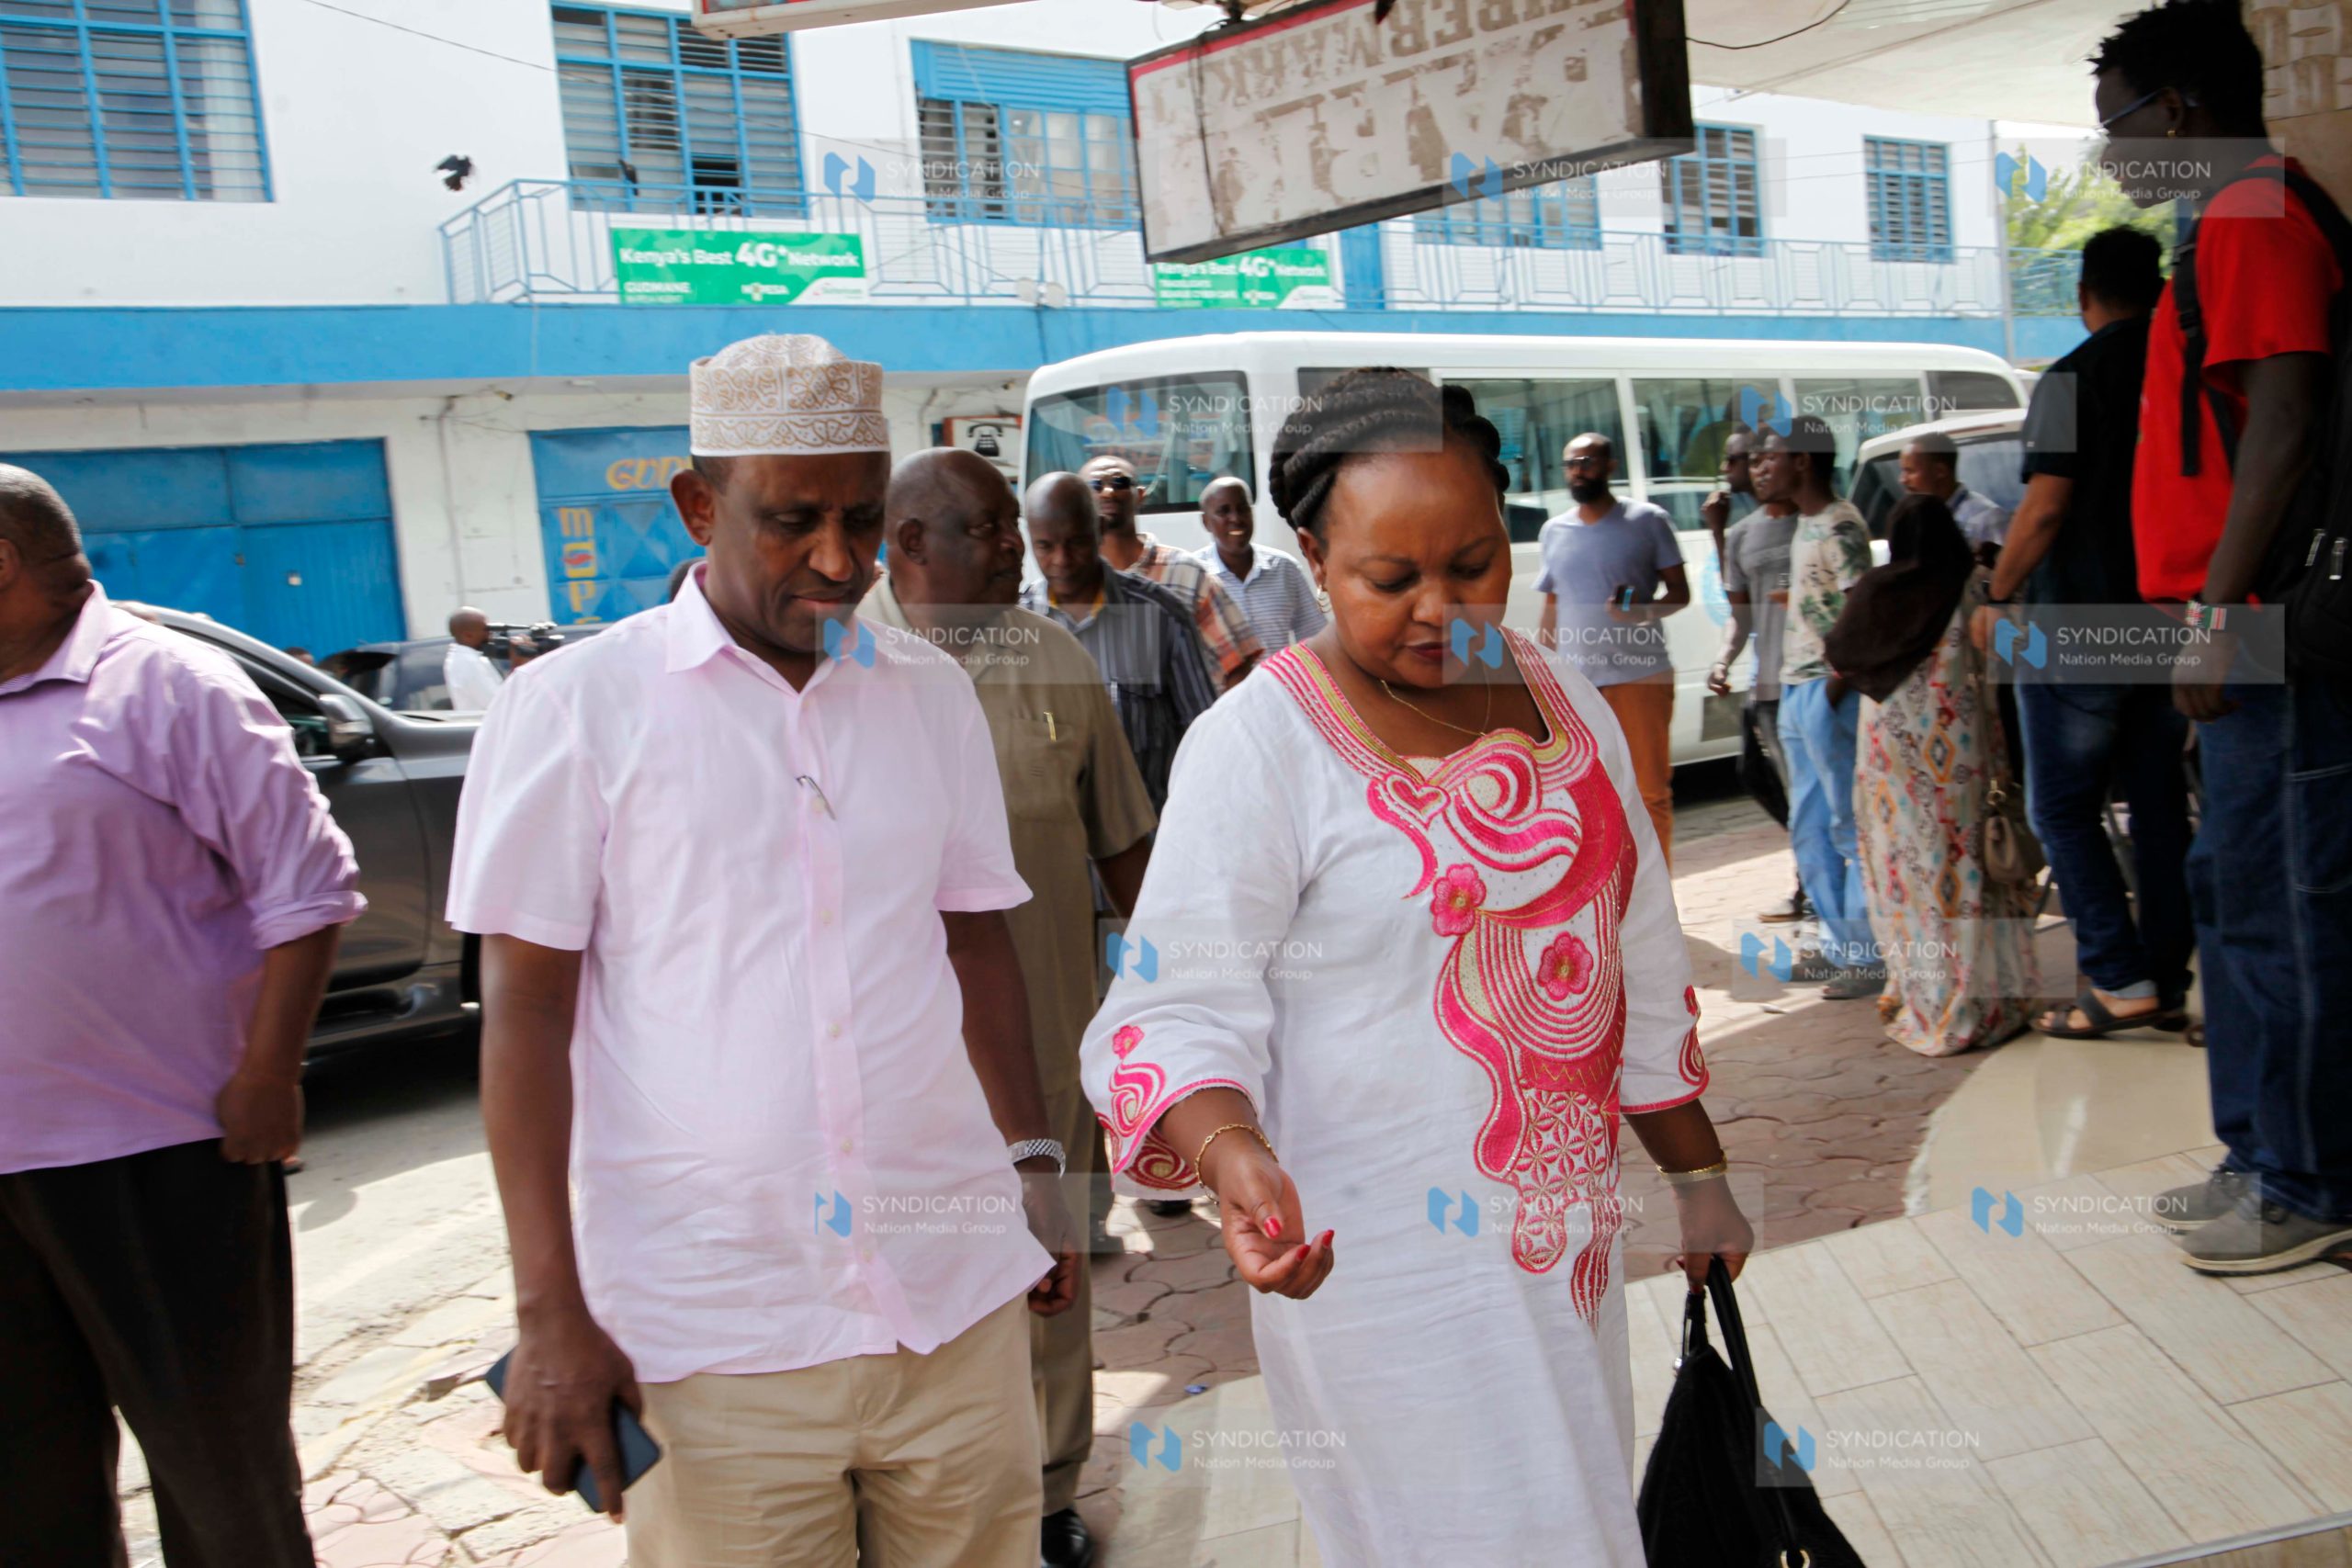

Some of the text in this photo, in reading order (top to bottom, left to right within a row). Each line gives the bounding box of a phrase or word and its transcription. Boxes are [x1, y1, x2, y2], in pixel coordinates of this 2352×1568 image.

[619, 248, 692, 267] Kenya's
[693, 249, 734, 265] Best
[787, 252, 861, 266] Network
